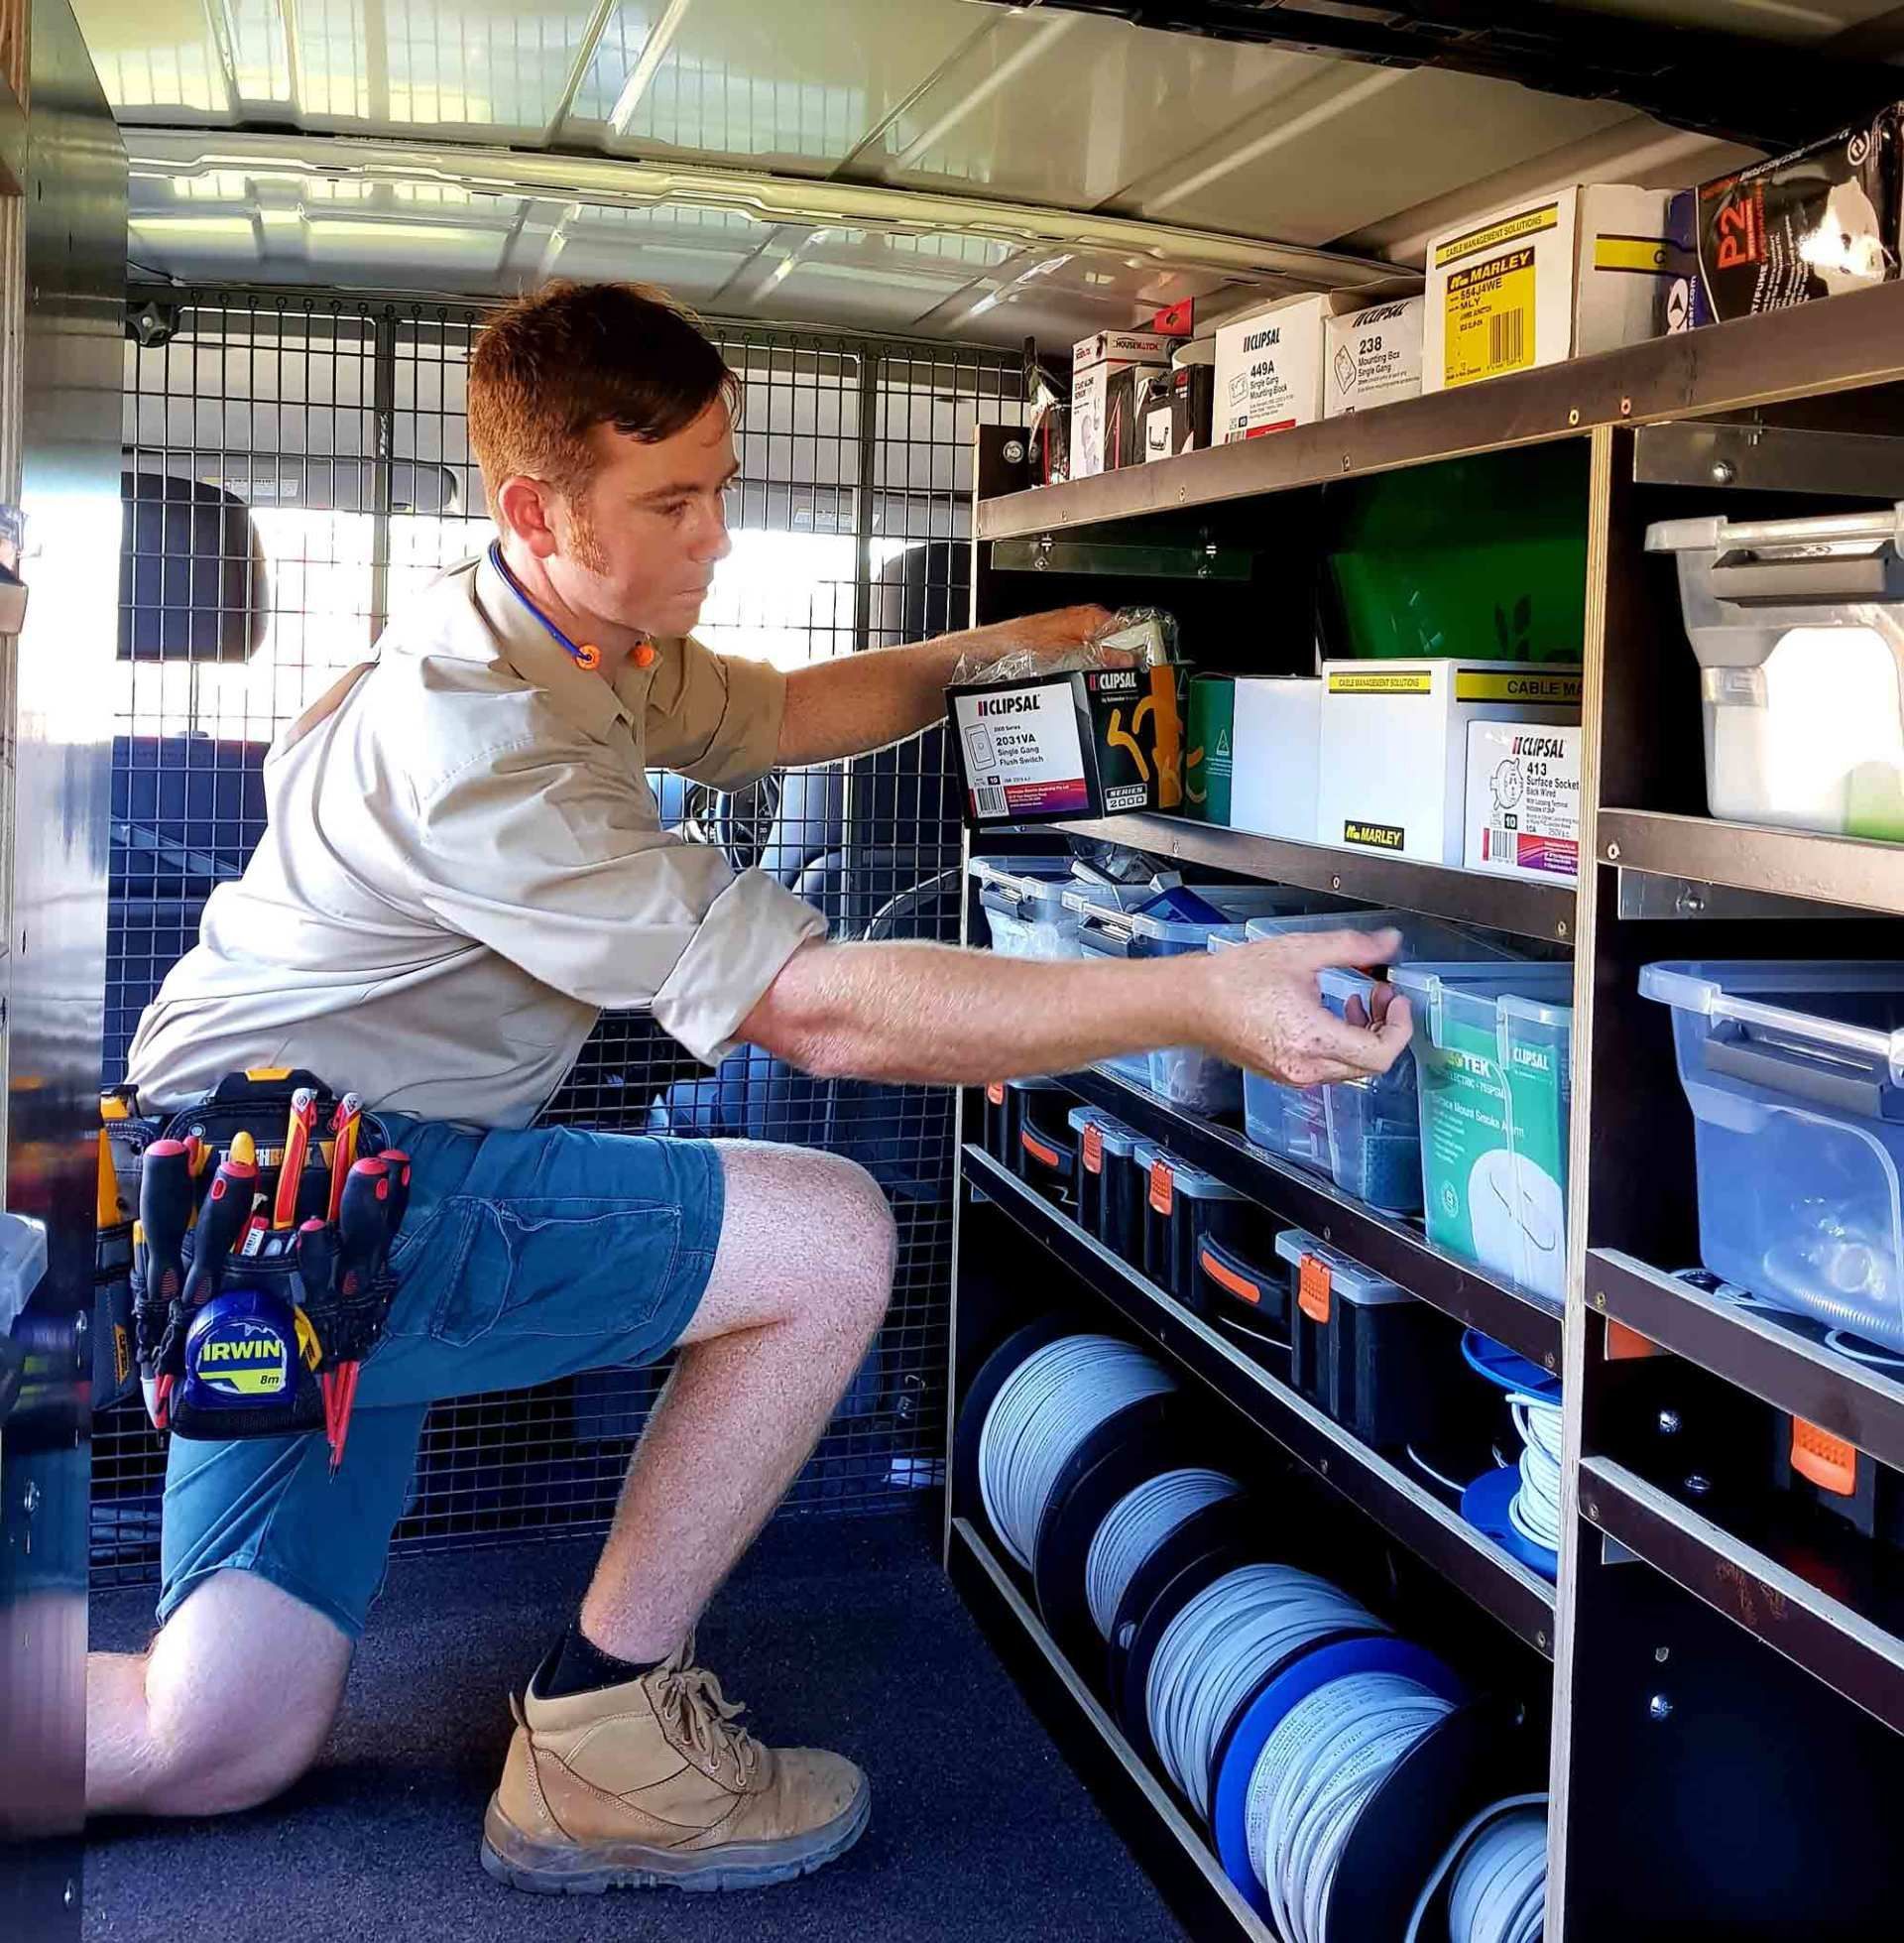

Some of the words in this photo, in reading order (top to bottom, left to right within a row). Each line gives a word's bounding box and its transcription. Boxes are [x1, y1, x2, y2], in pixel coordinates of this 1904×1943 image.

[1446, 244, 1464, 258] CABLE
[1464, 228, 1504, 251] MANAGEMENT
[1504, 215, 1543, 236] SOLUTIONS
[1719, 200, 1746, 268] P2
[1470, 250, 1531, 284] MARLEY
[1461, 297, 1481, 309] MLY
[1361, 301, 1410, 326] CLIPSAL
[1250, 327, 1280, 351] CLIPSAL
[1360, 335, 1382, 355] 238
[1358, 352, 1387, 367] Mounting
[1387, 350, 1400, 361] Box
[1250, 359, 1275, 378] 449A
[1358, 366, 1374, 378] Single
[1375, 363, 1392, 375] Gang
[1250, 379, 1265, 390] Single
[1266, 376, 1279, 388] Gang
[1250, 387, 1273, 401] Mounting
[1273, 382, 1287, 394] Block
[1099, 671, 1137, 690] CLIPSAL
[1339, 677, 1355, 686] CABLE
[1355, 677, 1389, 686] MANAGEMENT
[1390, 678, 1419, 687] SOLUTIONS
[1507, 680, 1559, 695] CABLE
[989, 694, 1041, 716] CLIPSAL
[996, 733, 1036, 747] 2031VA
[1522, 737, 1565, 759] CLIPSAL
[998, 748, 1019, 757] Single
[1020, 746, 1040, 756] Gang
[1000, 757, 1019, 767] Flush
[1019, 755, 1044, 764] Switch
[1526, 763, 1547, 777] 413
[1109, 787, 1143, 797] SERIES
[1526, 776, 1553, 789] Surface
[1555, 779, 1580, 791] Socket
[1109, 794, 1145, 808] 2000
[1539, 789, 1557, 798] Wired
[1505, 815, 1516, 827] 10
[1361, 826, 1401, 846] MARLEY
[1513, 1047, 1549, 1071] CLIPSAL
[1476, 1109, 1500, 1129] Smoke
[203, 1340, 282, 1362] IRWIN
[260, 1375, 280, 1386] 8m
